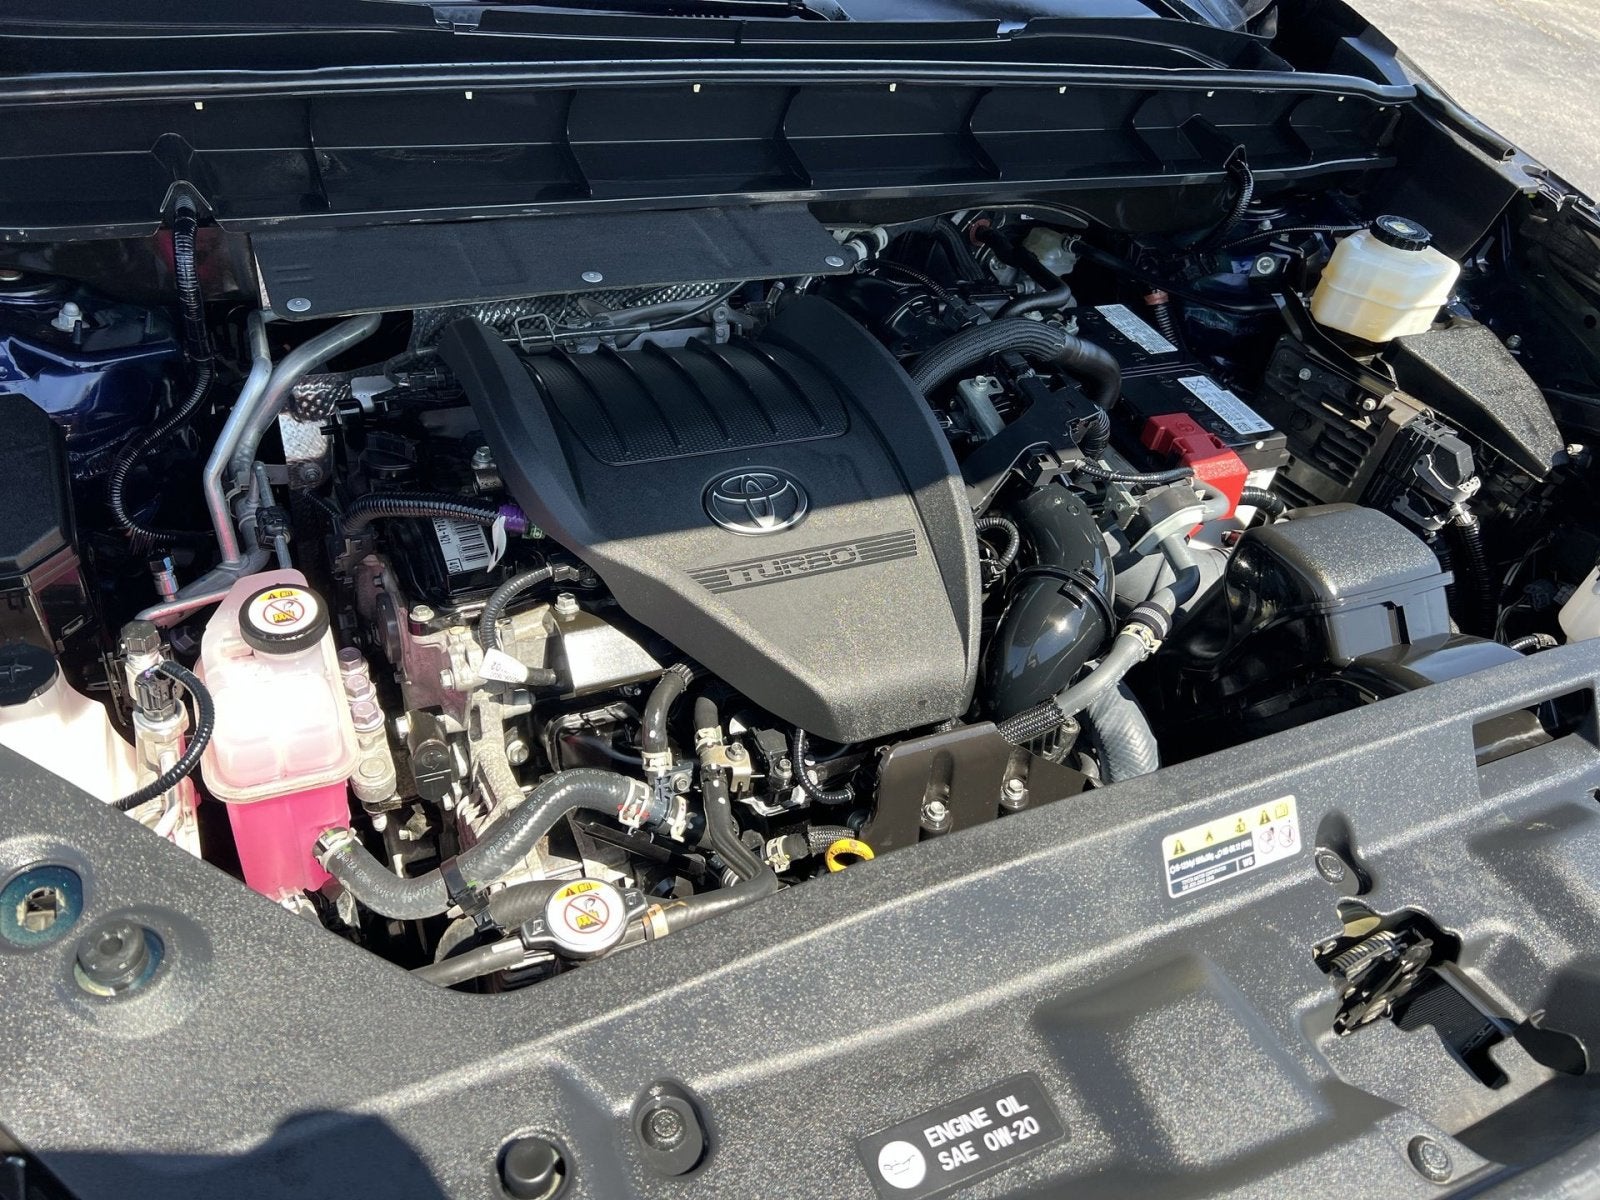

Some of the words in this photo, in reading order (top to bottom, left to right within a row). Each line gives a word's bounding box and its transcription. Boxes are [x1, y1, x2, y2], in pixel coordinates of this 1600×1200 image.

[729, 547, 857, 582] TURBO
[923, 1107, 993, 1148] ENGINE
[995, 1095, 1030, 1119] OIL
[938, 1140, 980, 1171] SAE
[983, 1116, 1041, 1152] 0W-20
